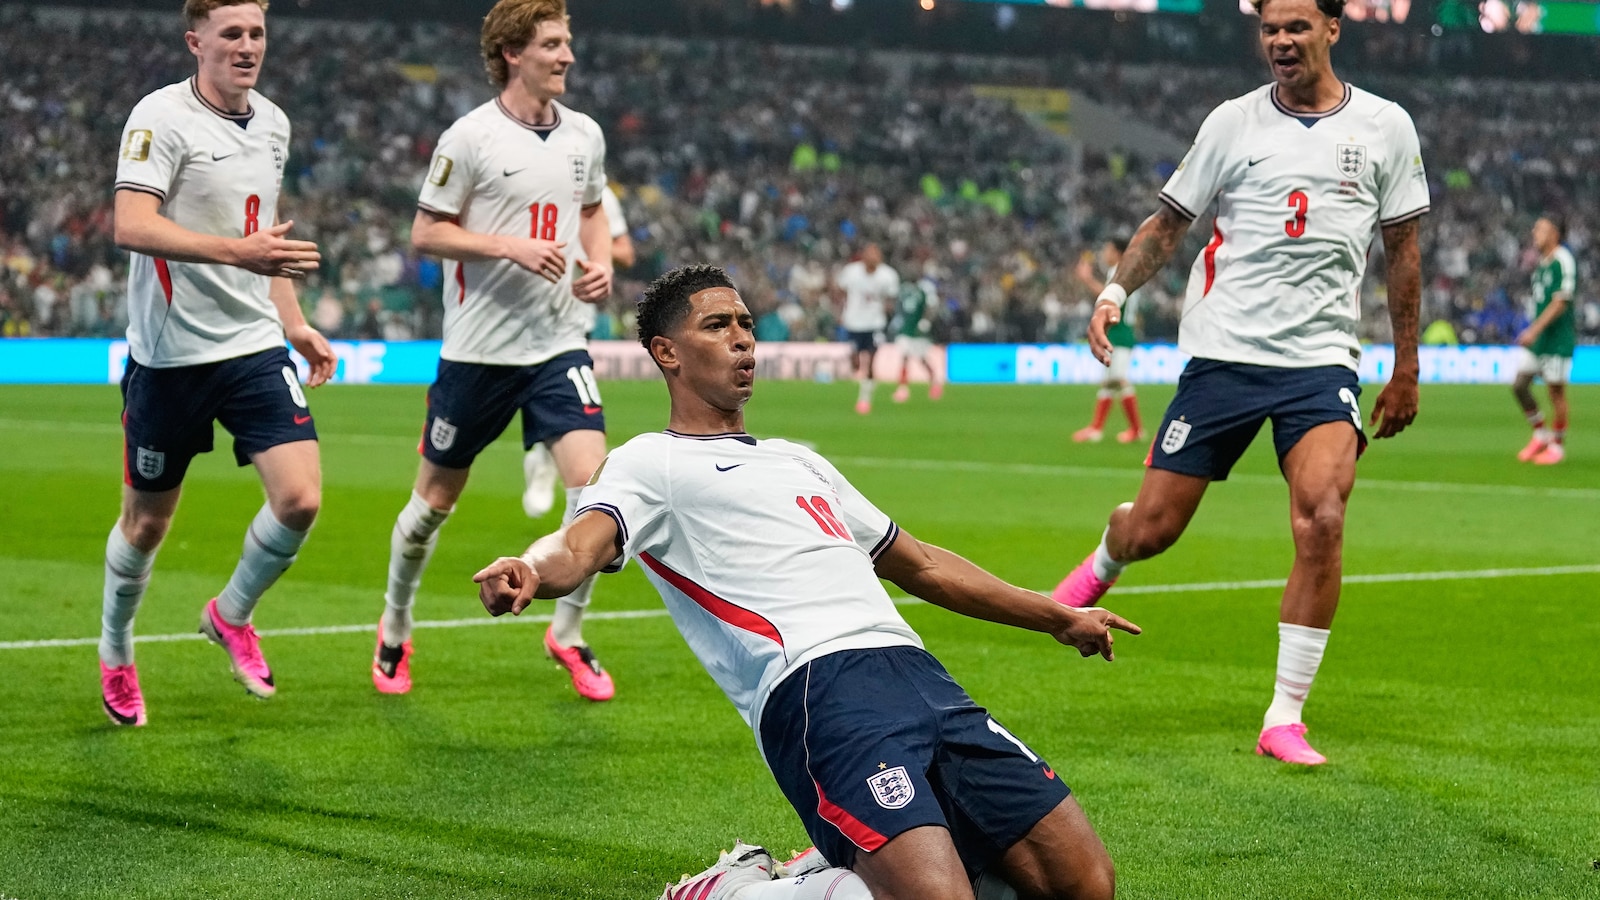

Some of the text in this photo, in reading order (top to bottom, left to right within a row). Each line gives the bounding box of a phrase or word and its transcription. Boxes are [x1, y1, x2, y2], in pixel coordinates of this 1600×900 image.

[244, 193, 261, 239] 8
[529, 202, 559, 242] 18
[1285, 190, 1309, 239] 3
[281, 365, 308, 409] 8
[1338, 387, 1363, 431] 3
[795, 495, 854, 543] 10
